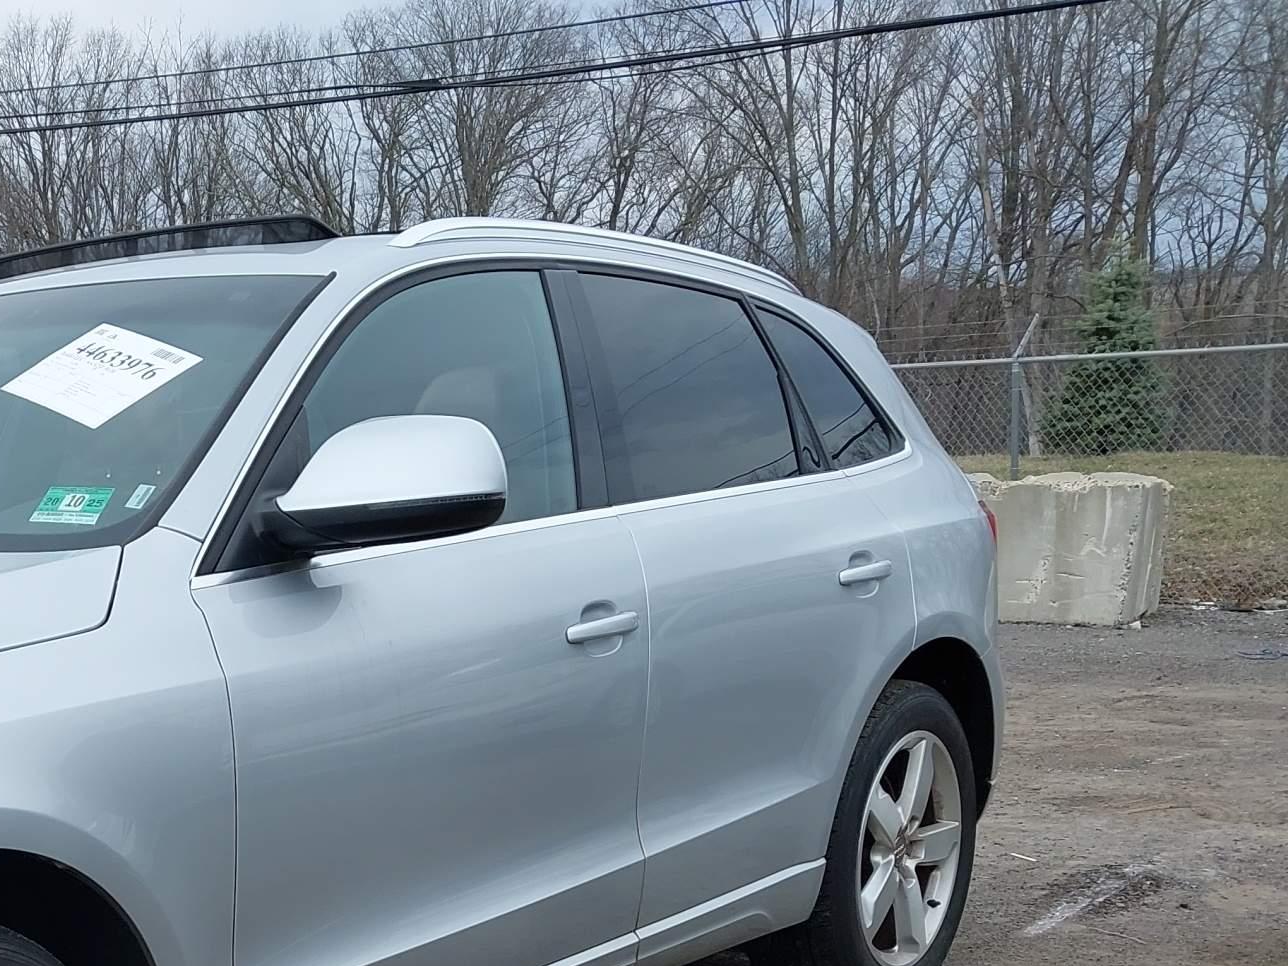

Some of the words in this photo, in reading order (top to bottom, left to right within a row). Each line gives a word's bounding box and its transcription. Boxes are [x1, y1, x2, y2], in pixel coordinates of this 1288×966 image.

[77, 342, 166, 380] 44633976
[43, 497, 60, 506] 20
[64, 494, 86, 508] 10
[86, 498, 105, 508] 25
